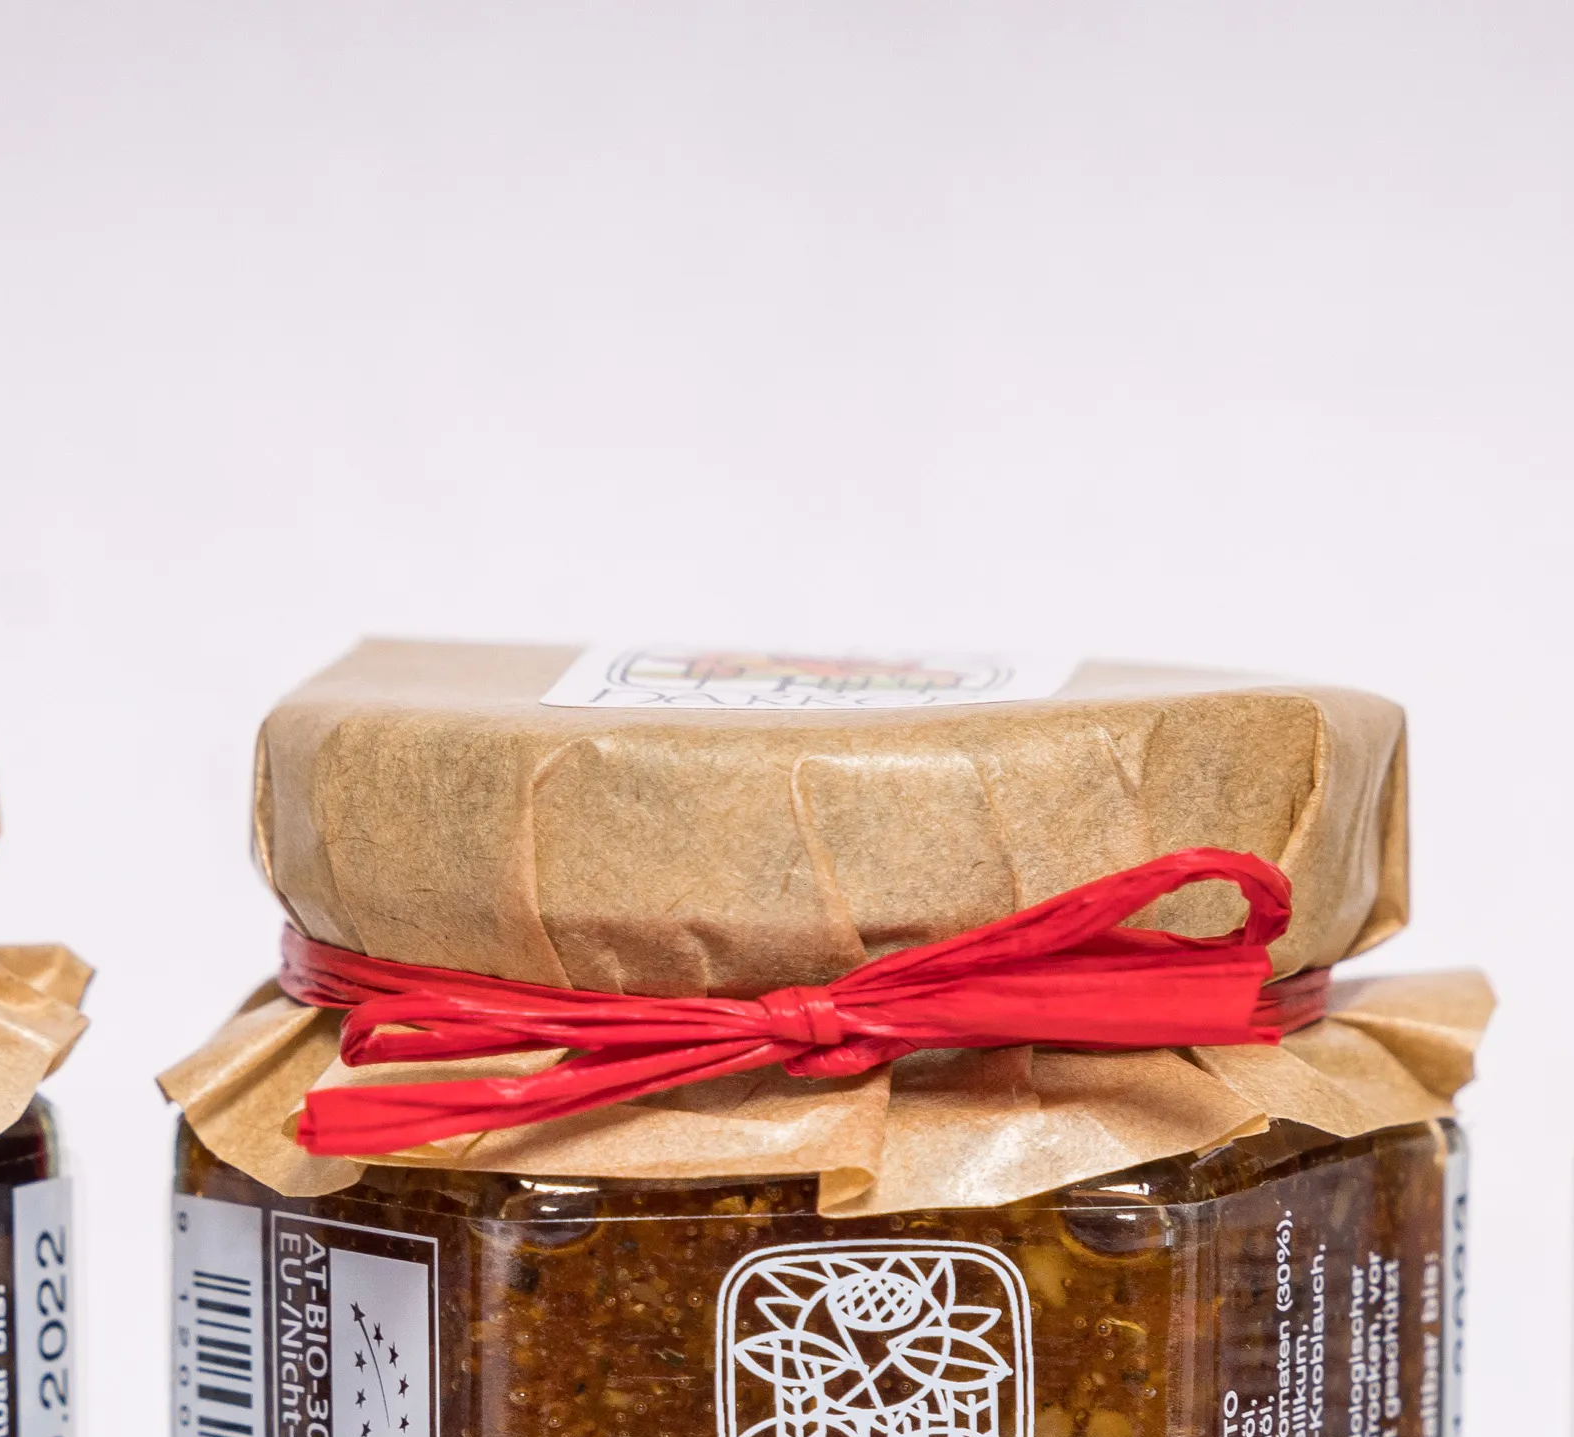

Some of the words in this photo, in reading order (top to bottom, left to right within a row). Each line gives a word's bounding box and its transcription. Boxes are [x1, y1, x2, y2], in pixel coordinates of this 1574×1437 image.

[1275, 1209, 1294, 1311] (30%),
[1368, 1250, 1382, 1304] vor
[1380, 1258, 1402, 1419] geschützt
